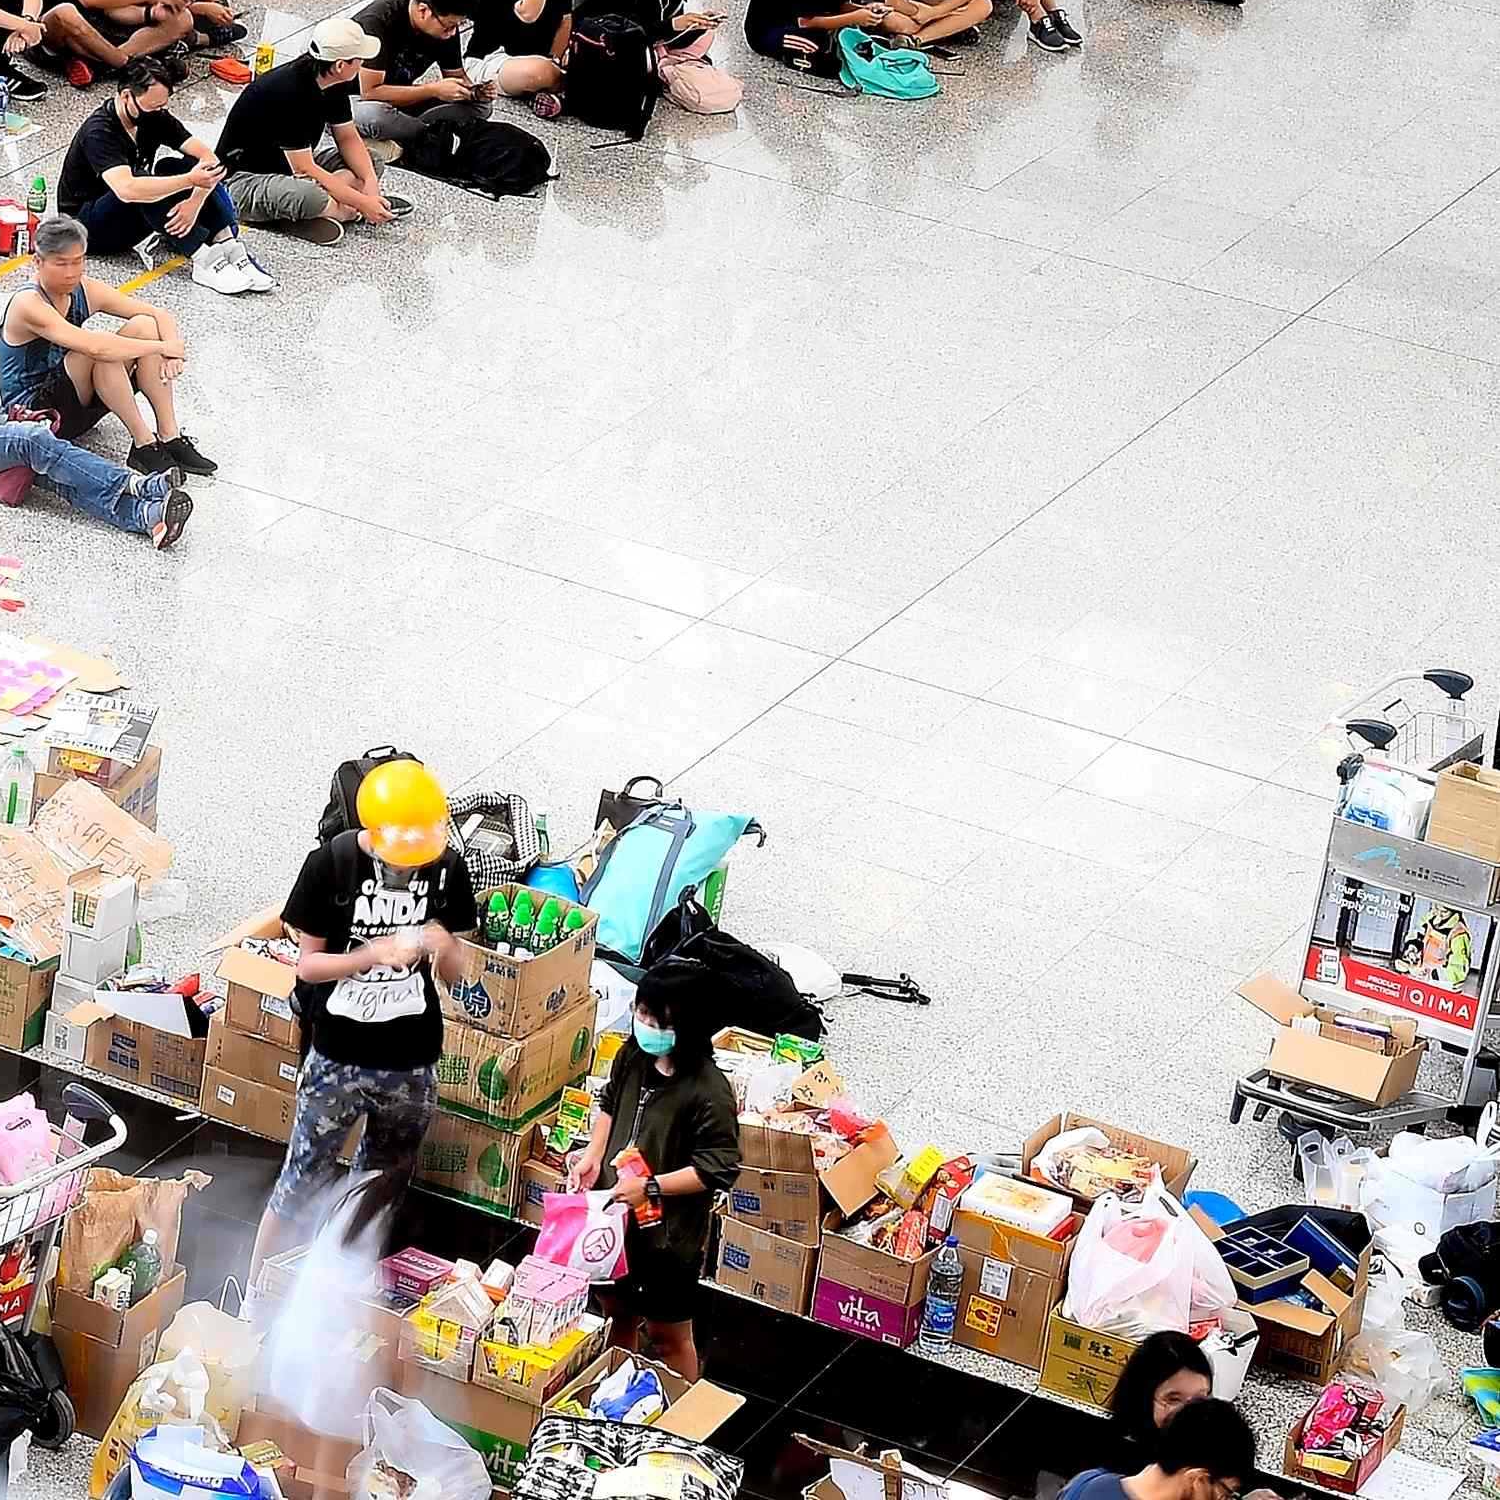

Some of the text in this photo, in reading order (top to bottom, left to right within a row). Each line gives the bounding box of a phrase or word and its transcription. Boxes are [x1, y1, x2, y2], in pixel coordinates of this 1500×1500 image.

[1328, 893, 1365, 913] Supply
[1331, 881, 1356, 895] Your
[1356, 887, 1381, 903] Eyes
[1409, 988, 1471, 1020] QIMA
[837, 1295, 881, 1328] vita
